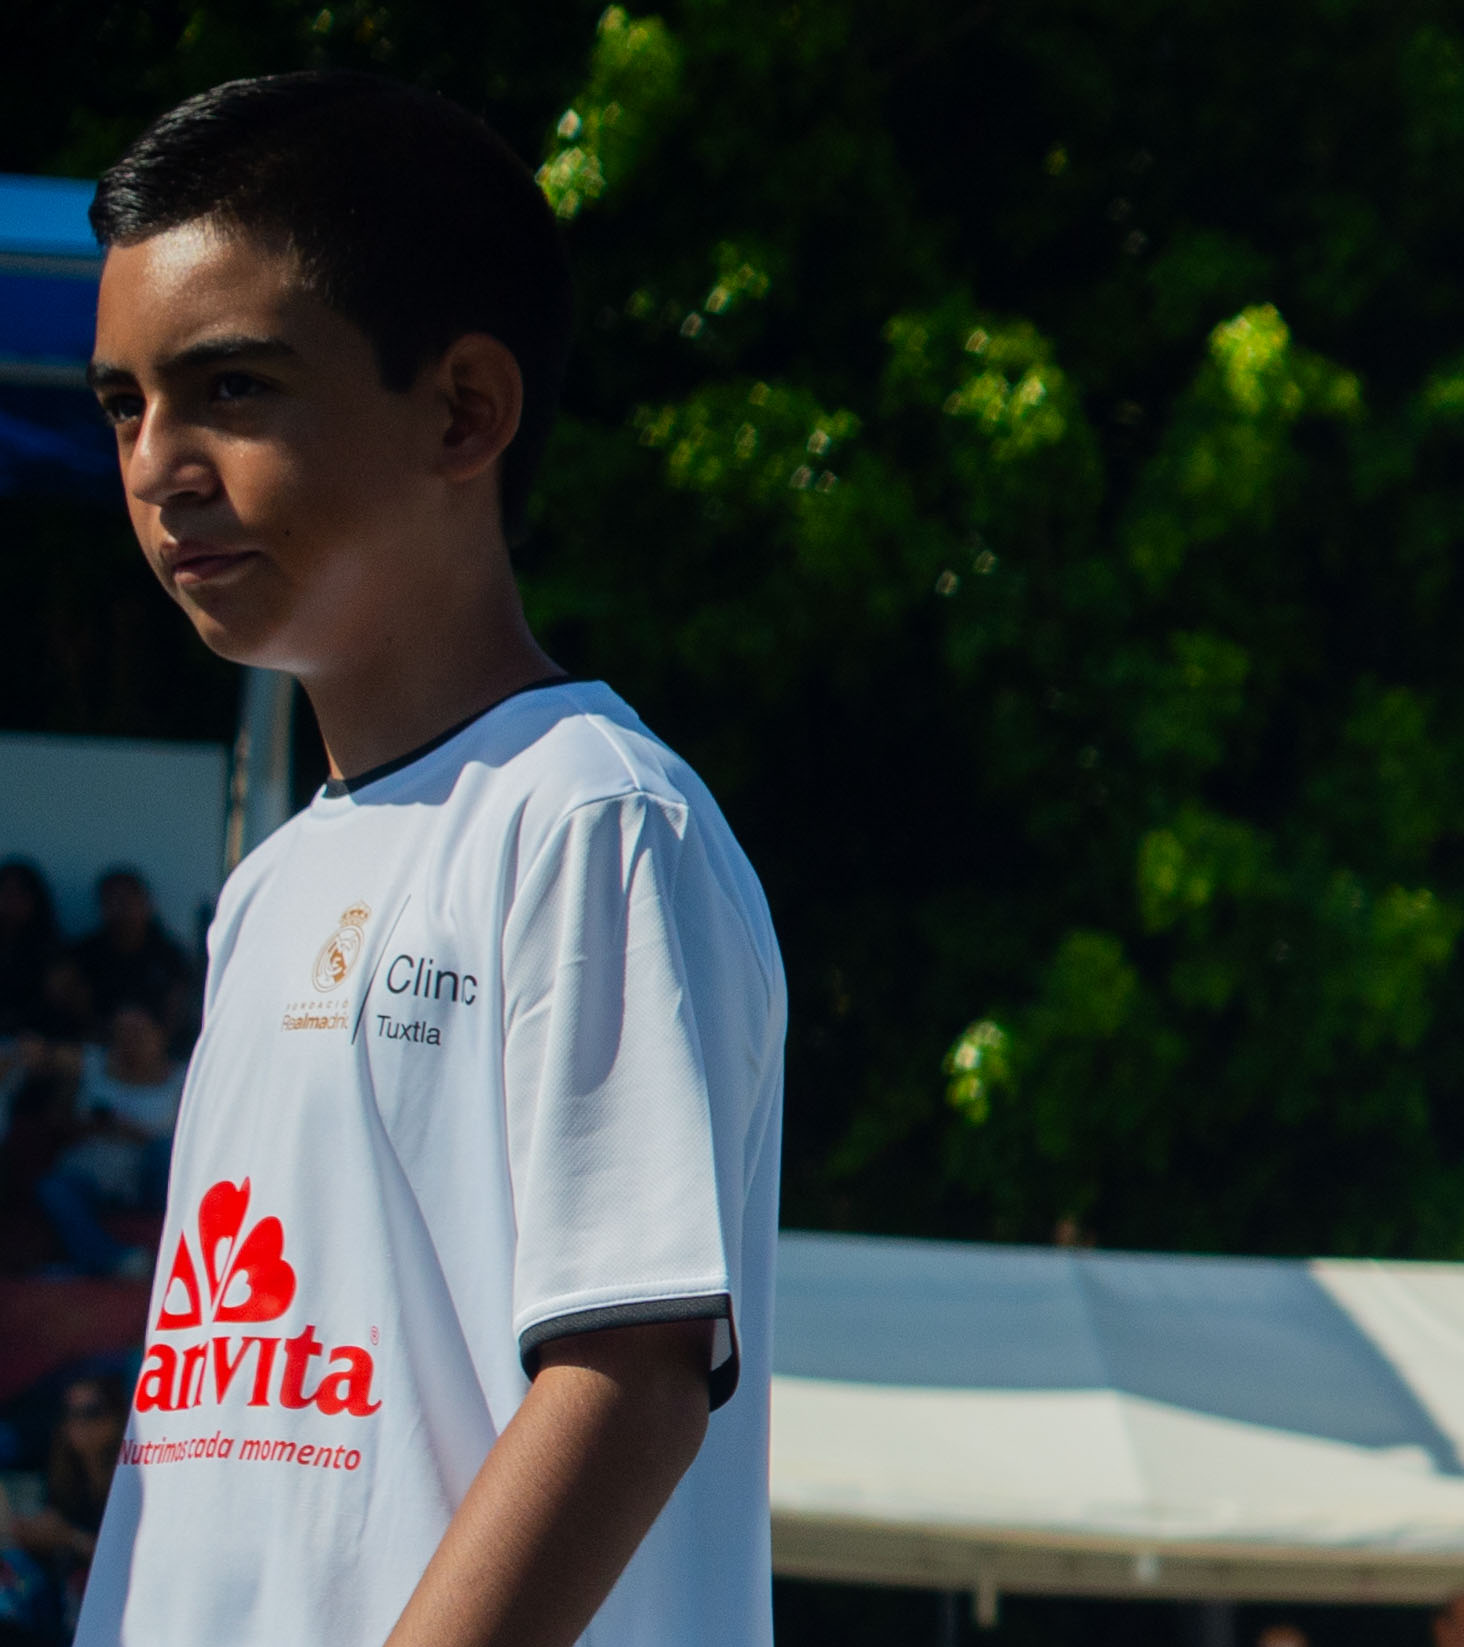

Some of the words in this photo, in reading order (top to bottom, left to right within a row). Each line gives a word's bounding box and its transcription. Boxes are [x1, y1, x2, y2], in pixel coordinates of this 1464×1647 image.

[286, 999, 349, 1010] FUNDACIÓ
[376, 1014, 442, 1046] Tuxtla
[133, 1324, 382, 1417] anvita
[187, 1430, 234, 1459] cada
[238, 1437, 361, 1471] momento
